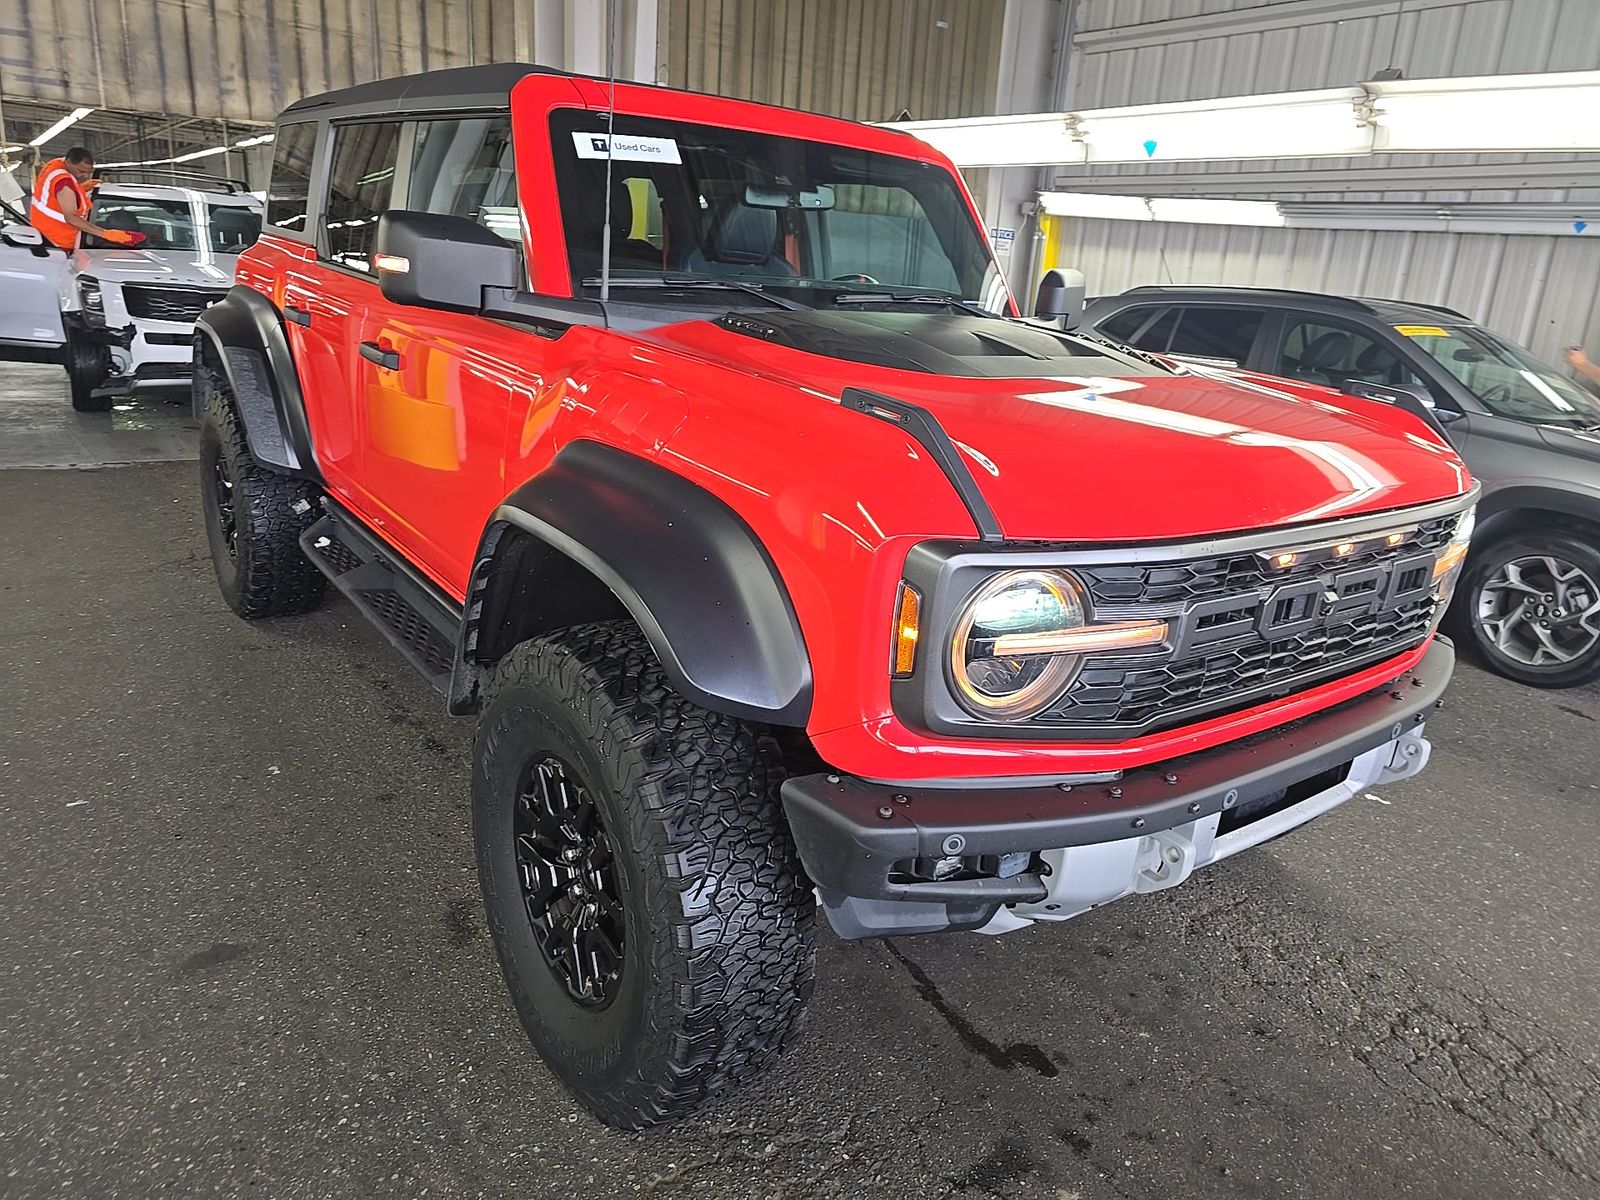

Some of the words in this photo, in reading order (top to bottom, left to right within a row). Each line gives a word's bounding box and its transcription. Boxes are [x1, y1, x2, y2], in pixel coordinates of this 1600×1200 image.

[614, 142, 638, 151] Used
[640, 144, 661, 153] Cars
[1169, 553, 1437, 661] FORD
